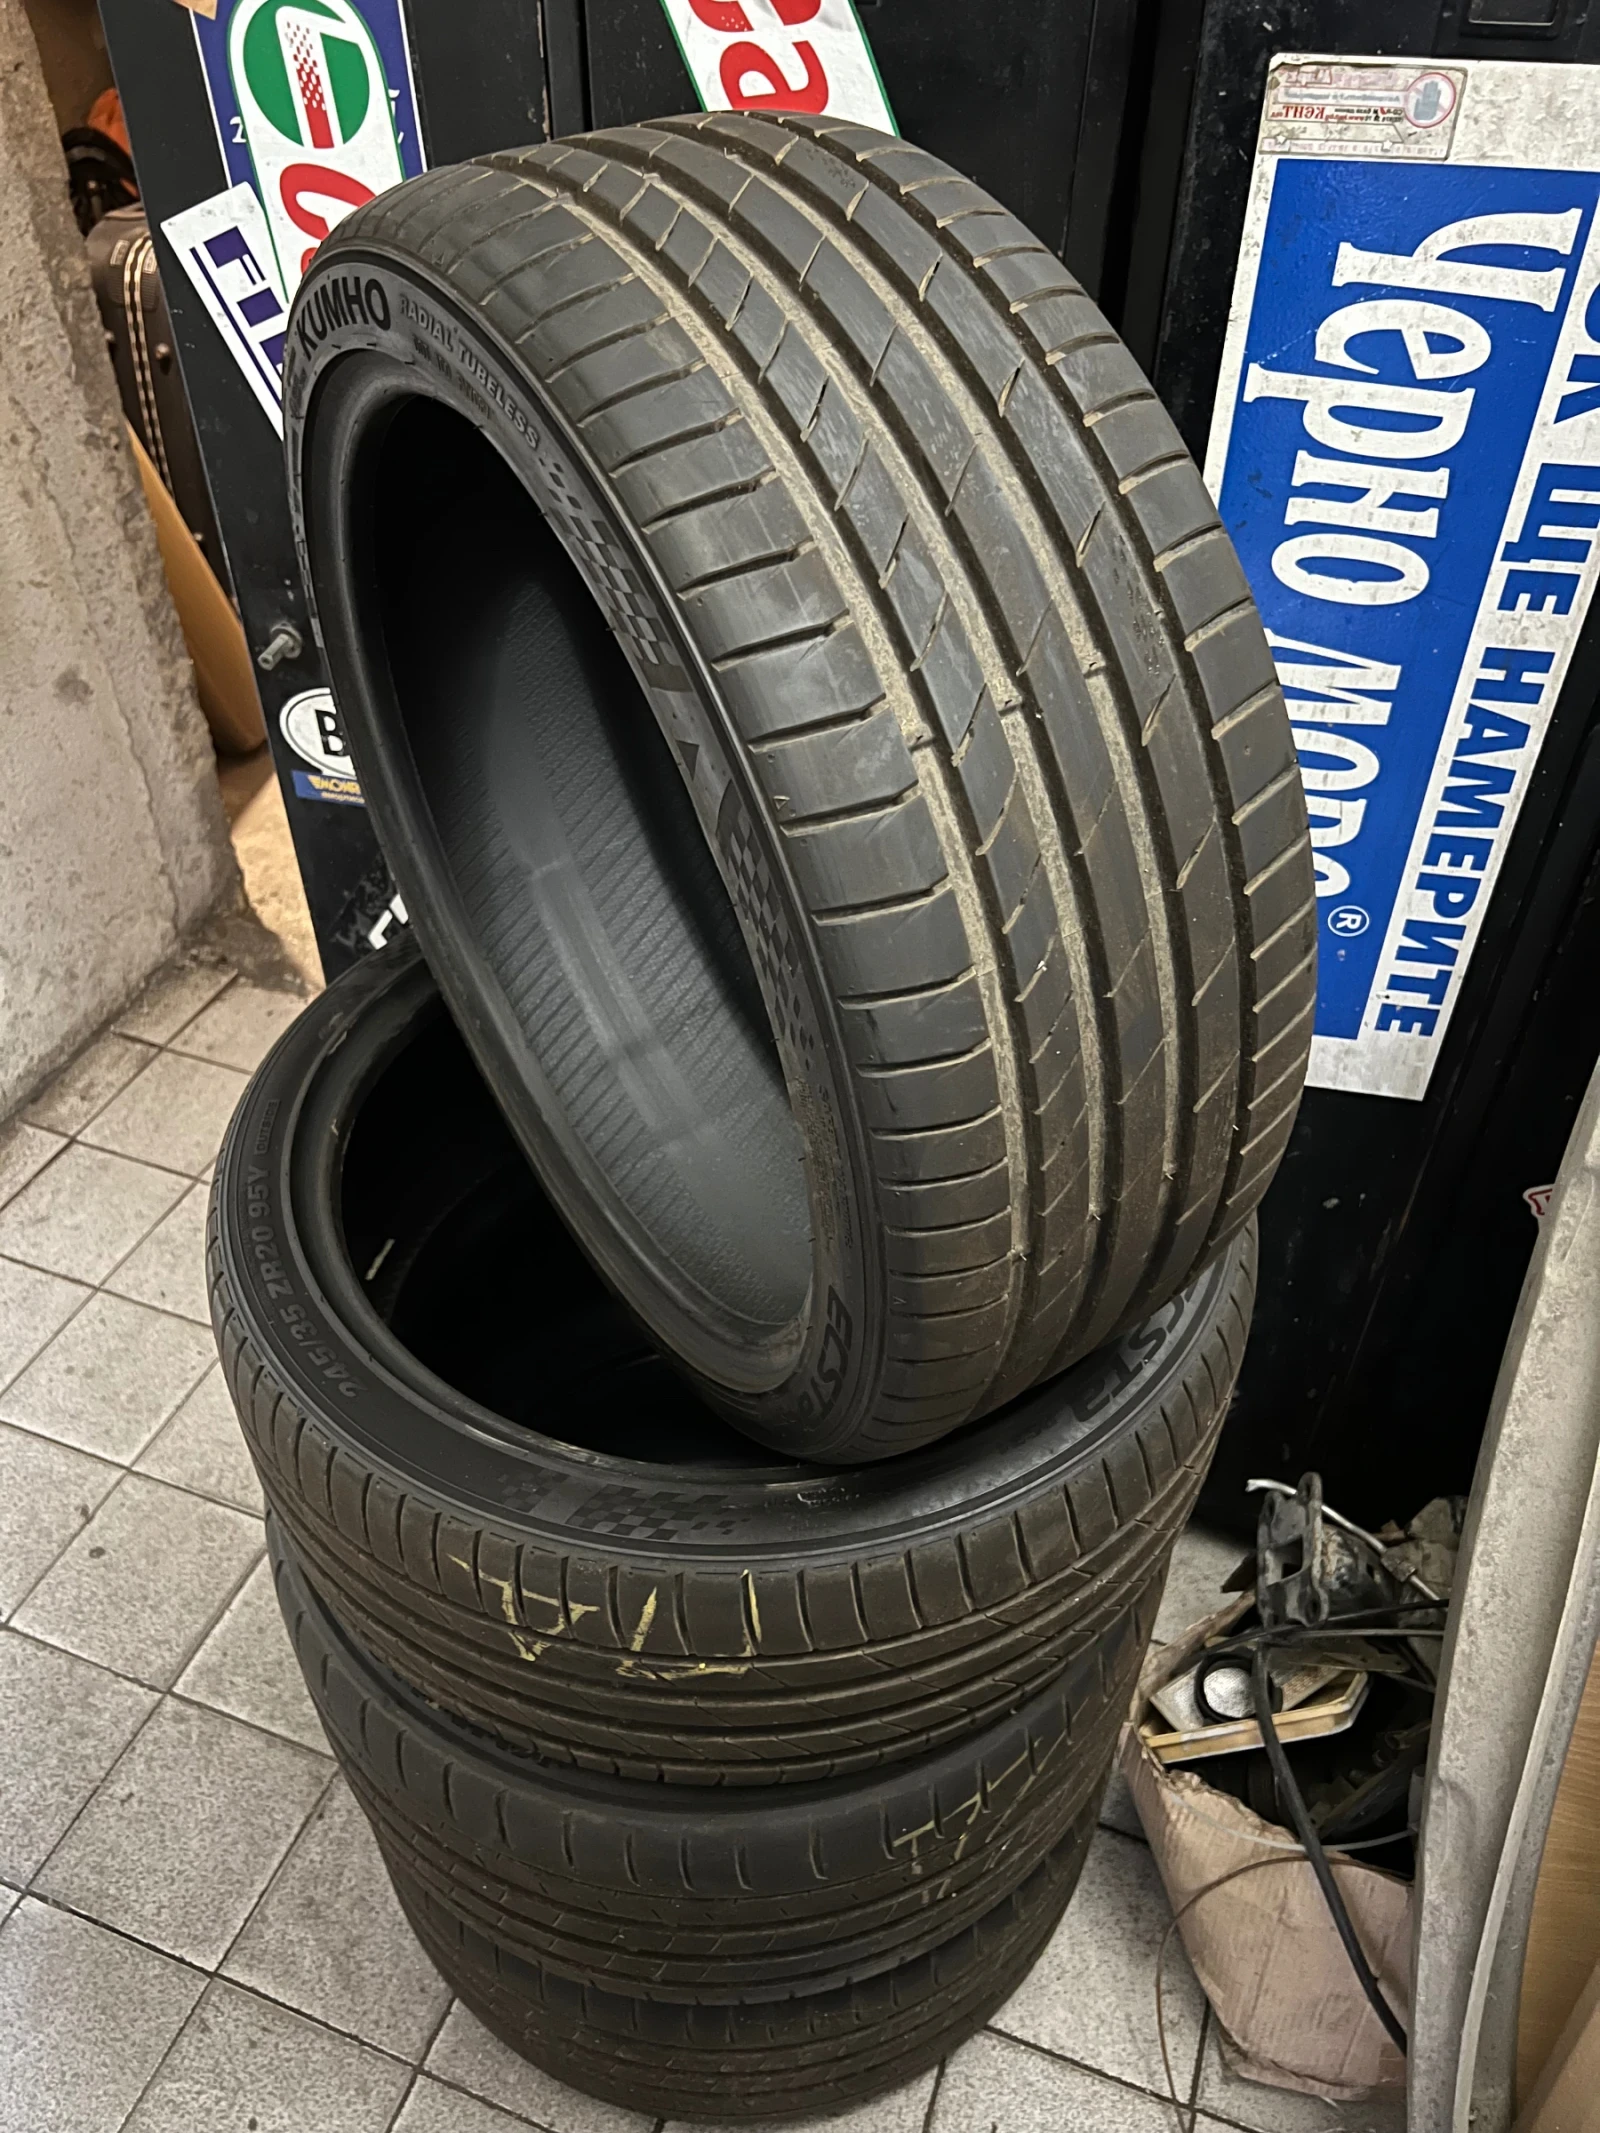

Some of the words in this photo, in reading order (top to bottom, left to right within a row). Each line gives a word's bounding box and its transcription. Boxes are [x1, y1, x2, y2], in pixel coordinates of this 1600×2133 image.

[203, 226, 286, 383] FIL
[296, 275, 392, 362] KUMHO
[400, 292, 456, 352] RADIAL
[455, 339, 541, 452] TUBELESS
[1243, 208, 1583, 606] Черно
[1496, 462, 1600, 616] ЩЕ
[314, 709, 351, 758] B
[1265, 628, 1402, 898] мо
[1374, 646, 1556, 1038] НАМЕРИТЕ
[256, 1099, 280, 1154] OUTSIDE
[248, 1165, 271, 1219] 95Y
[251, 1225, 295, 1300] ZR20
[279, 1305, 368, 1398] 245/35
